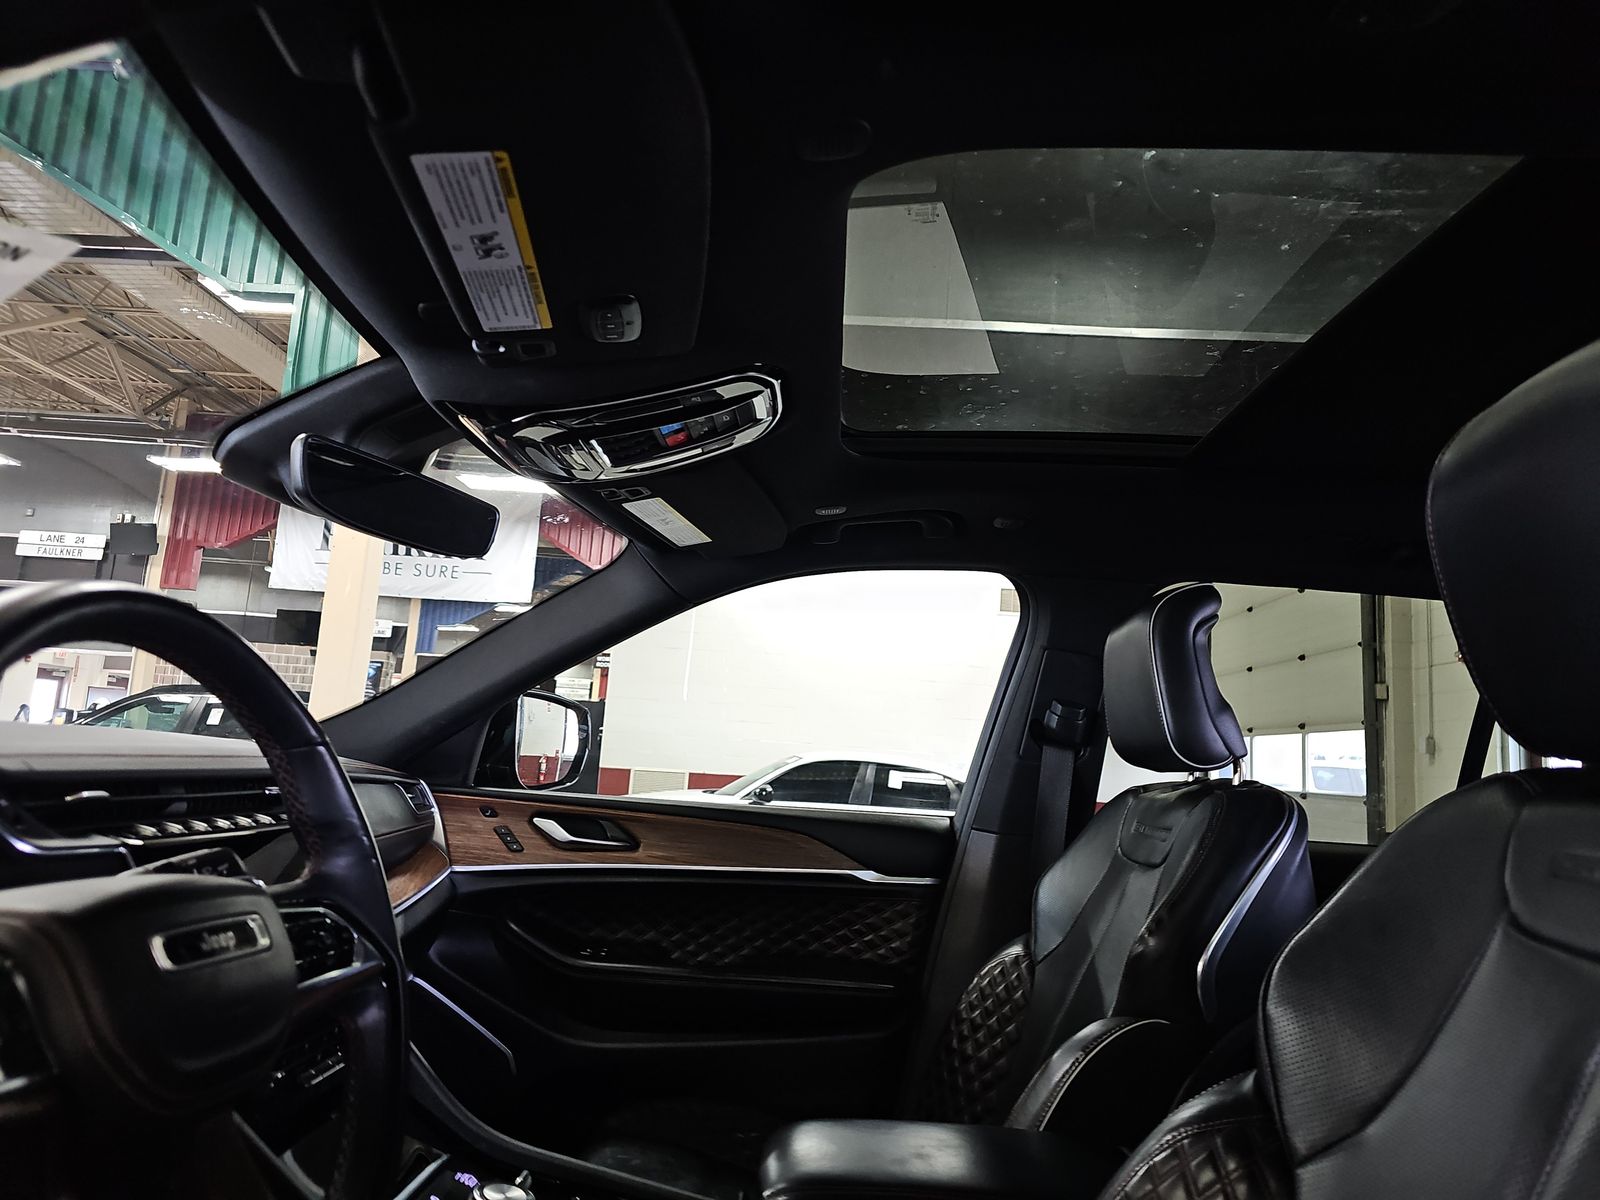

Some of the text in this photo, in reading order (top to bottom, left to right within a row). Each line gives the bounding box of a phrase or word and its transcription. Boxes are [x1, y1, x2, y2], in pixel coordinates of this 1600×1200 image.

[39, 534, 85, 545] LANE 24
[36, 546, 84, 557] FAULKNER
[382, 561, 460, 579] BE SURE
